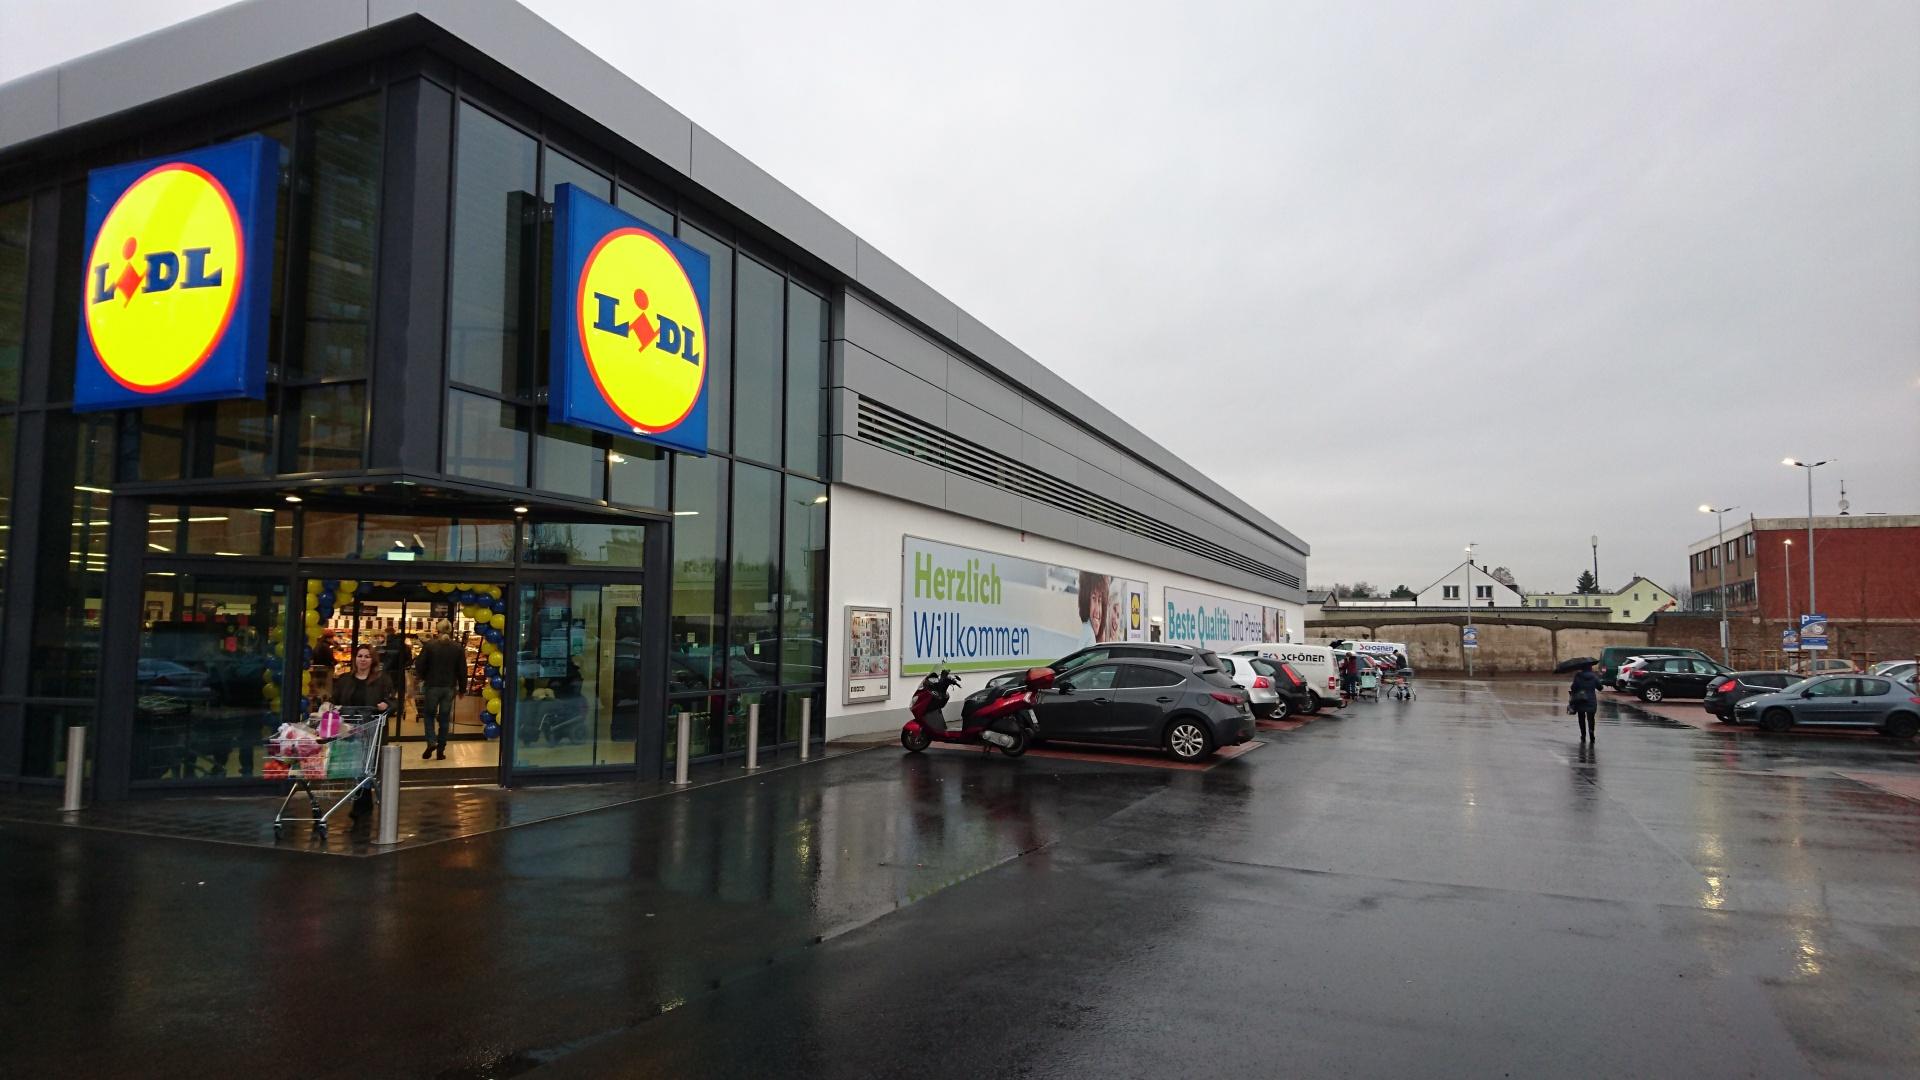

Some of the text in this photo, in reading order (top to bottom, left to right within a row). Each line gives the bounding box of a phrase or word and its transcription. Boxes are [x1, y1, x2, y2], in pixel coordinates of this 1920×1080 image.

[914, 551, 1001, 605] Herzlich
[914, 611, 1029, 658] Willkommen
[1168, 601, 1262, 649] Beste Qualität und Preise
[1801, 615, 1809, 624] P
